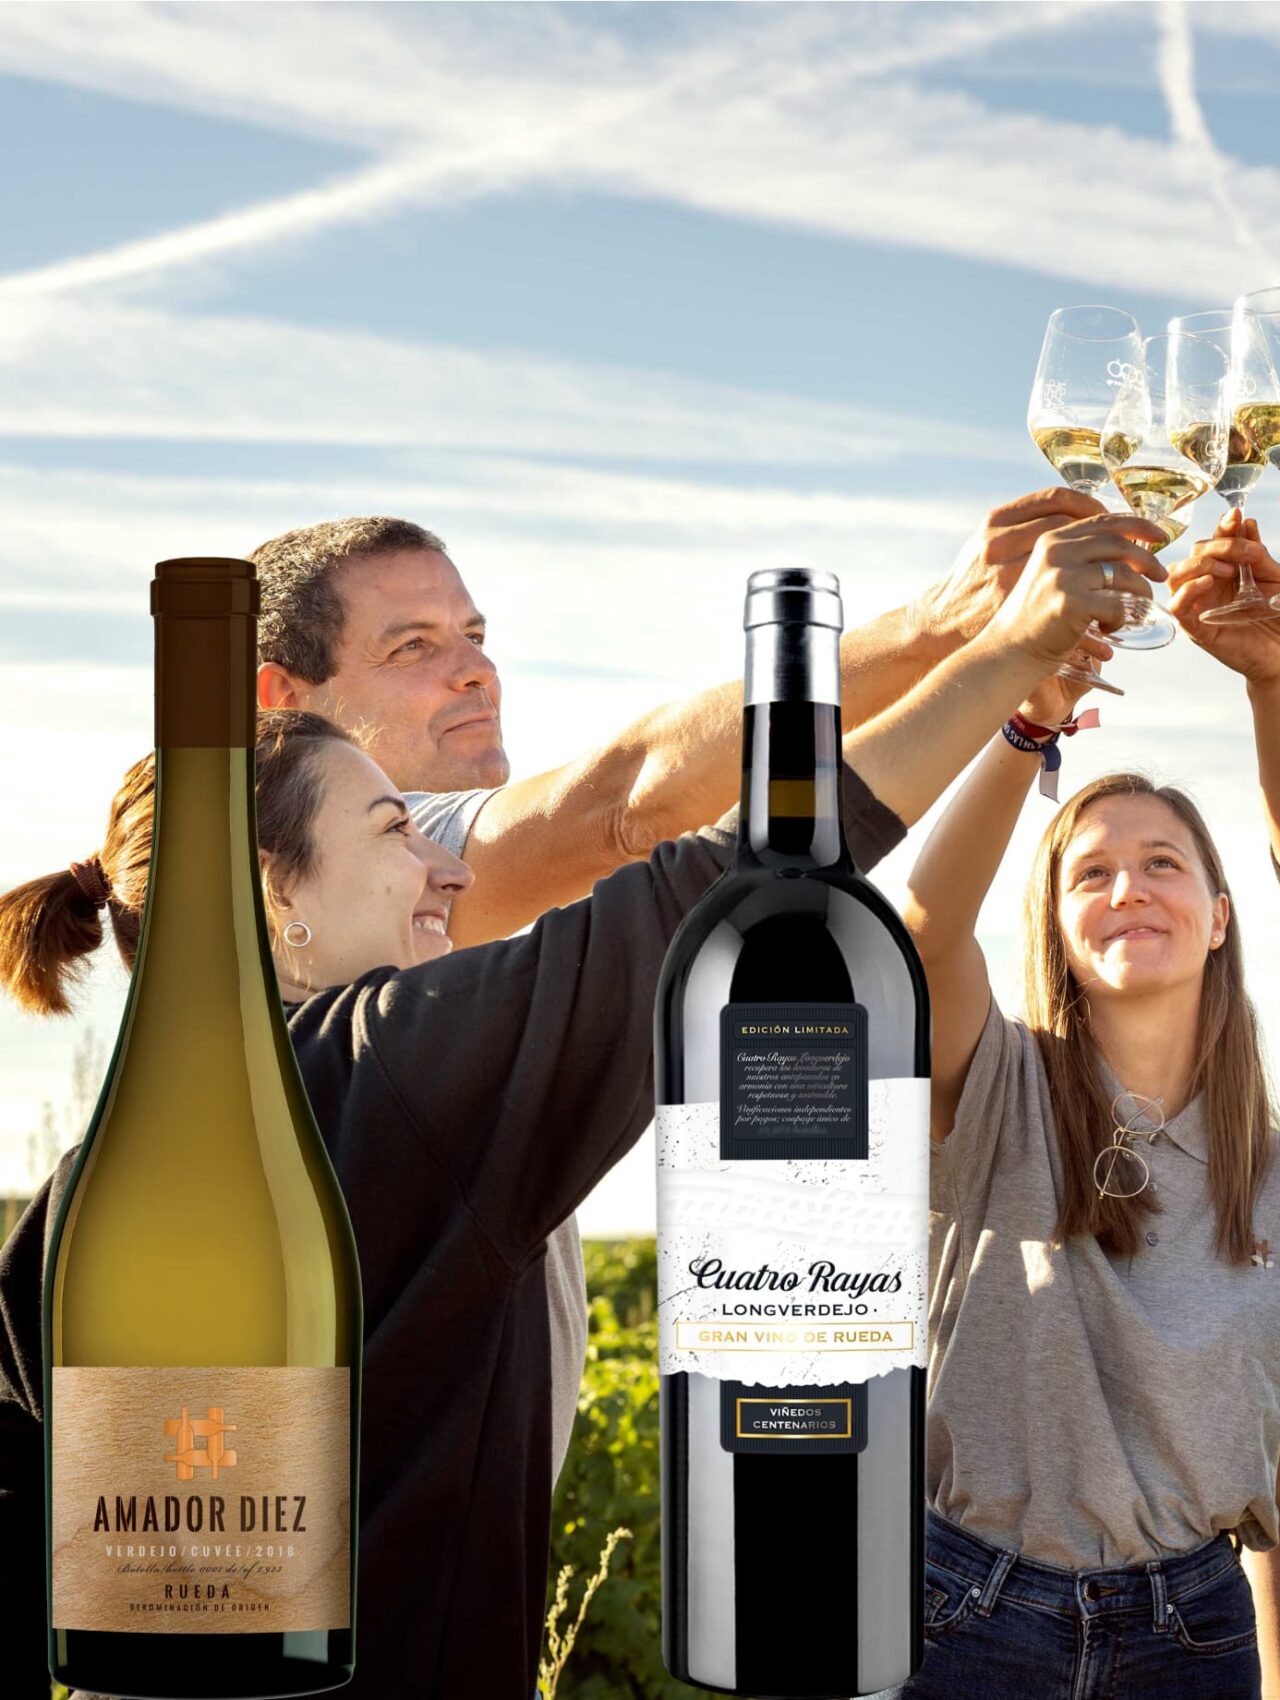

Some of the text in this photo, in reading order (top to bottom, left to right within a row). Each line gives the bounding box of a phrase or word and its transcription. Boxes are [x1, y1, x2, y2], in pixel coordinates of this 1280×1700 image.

[741, 1025, 849, 1034] EDICIÓN LIMITADA
[737, 1052, 766, 1062] Cuatro
[767, 1051, 797, 1065] Rayas
[744, 1065, 778, 1074] recupera
[793, 1104, 851, 1116] independientes
[840, 1113, 851, 1122] de
[689, 1259, 902, 1300] Cuatro Rayas
[722, 1303, 868, 1316] LONGVERDEJO
[698, 1330, 893, 1343] GRAN VINO DE RUEDA
[770, 1406, 821, 1417] VIÑEDOS
[753, 1420, 836, 1429] CENTENARIOS
[93, 1495, 306, 1532] AMADOR DIEZ
[165, 1584, 230, 1599] RUEDA
[129, 1603, 270, 1612] DENOMINACIÓN DE ORIGEN
